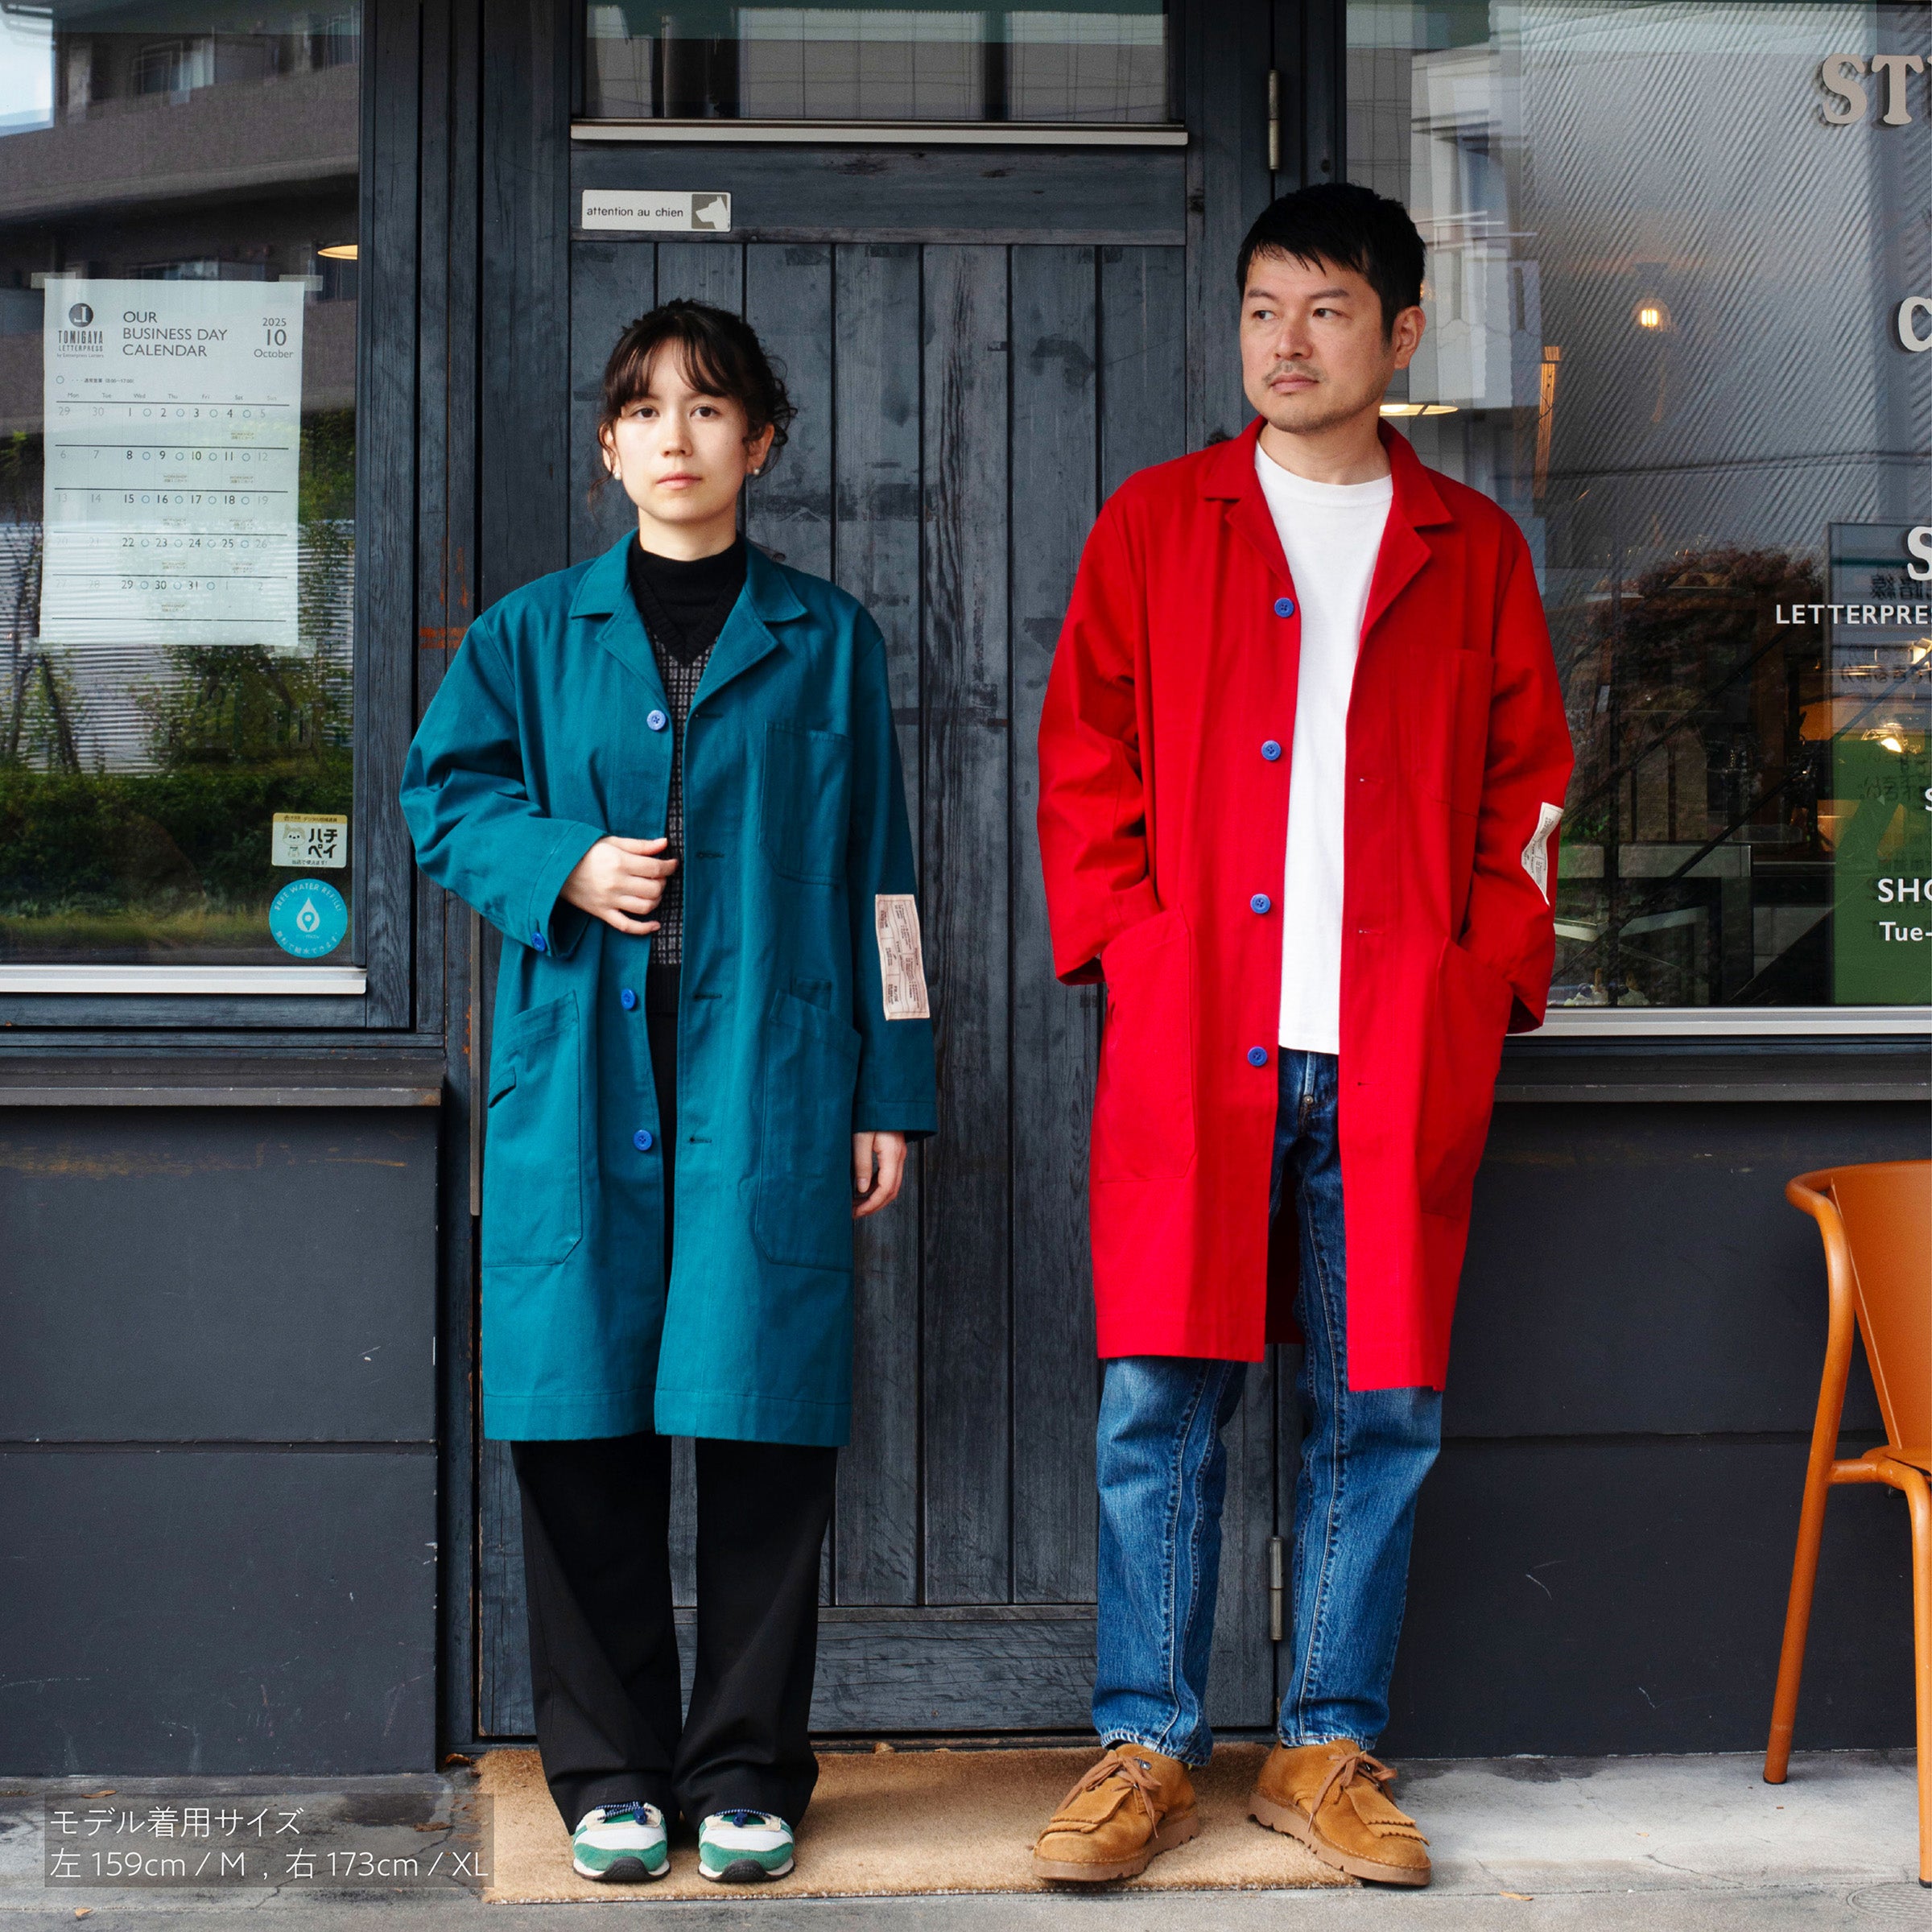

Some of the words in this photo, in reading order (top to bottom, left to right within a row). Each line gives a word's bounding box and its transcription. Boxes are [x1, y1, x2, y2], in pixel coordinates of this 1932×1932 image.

[1822, 53, 1932, 125] ST
[587, 207, 633, 216] attention
[655, 208, 683, 217] chien
[123, 312, 157, 323] OUR
[263, 318, 286, 326] 2025
[58, 331, 104, 345] TOMIGAYA
[124, 328, 192, 340] BUSINESS
[198, 329, 227, 341] DAY
[267, 329, 287, 345] 10
[123, 345, 207, 357] CALENDAR
[254, 349, 293, 358] October
[59, 407, 70, 415] 29
[93, 407, 104, 416] 30
[129, 407, 132, 417] 1
[161, 408, 166, 417] 2
[194, 408, 199, 417] 3
[227, 410, 233, 418] 4
[261, 409, 266, 418] 5
[60, 450, 66, 458] 6
[94, 450, 99, 459] 7
[126, 451, 132, 460] 8
[159, 451, 165, 459] 9
[192, 452, 201, 460] 10
[225, 452, 233, 460] 11
[258, 452, 268, 461] 12
[125, 494, 134, 503] 15
[158, 495, 167, 503] 16
[192, 495, 201, 503] 17
[225, 495, 235, 504] 18
[258, 496, 268, 505] 19
[122, 538, 134, 547] 22
[156, 539, 167, 547] 23
[189, 539, 200, 547] 24
[222, 539, 233, 547] 25
[255, 539, 267, 548] 26
[1907, 526, 1932, 580] S
[122, 580, 133, 588] 29
[155, 580, 167, 589] 30
[189, 580, 198, 590] 31
[258, 582, 263, 591] 2
[1776, 605, 1932, 625] LETTERPRE
[308, 828, 337, 843] ハチ
[308, 844, 336, 858] ペイ
[275, 892, 289, 910] FREE
[290, 882, 320, 893] WATER
